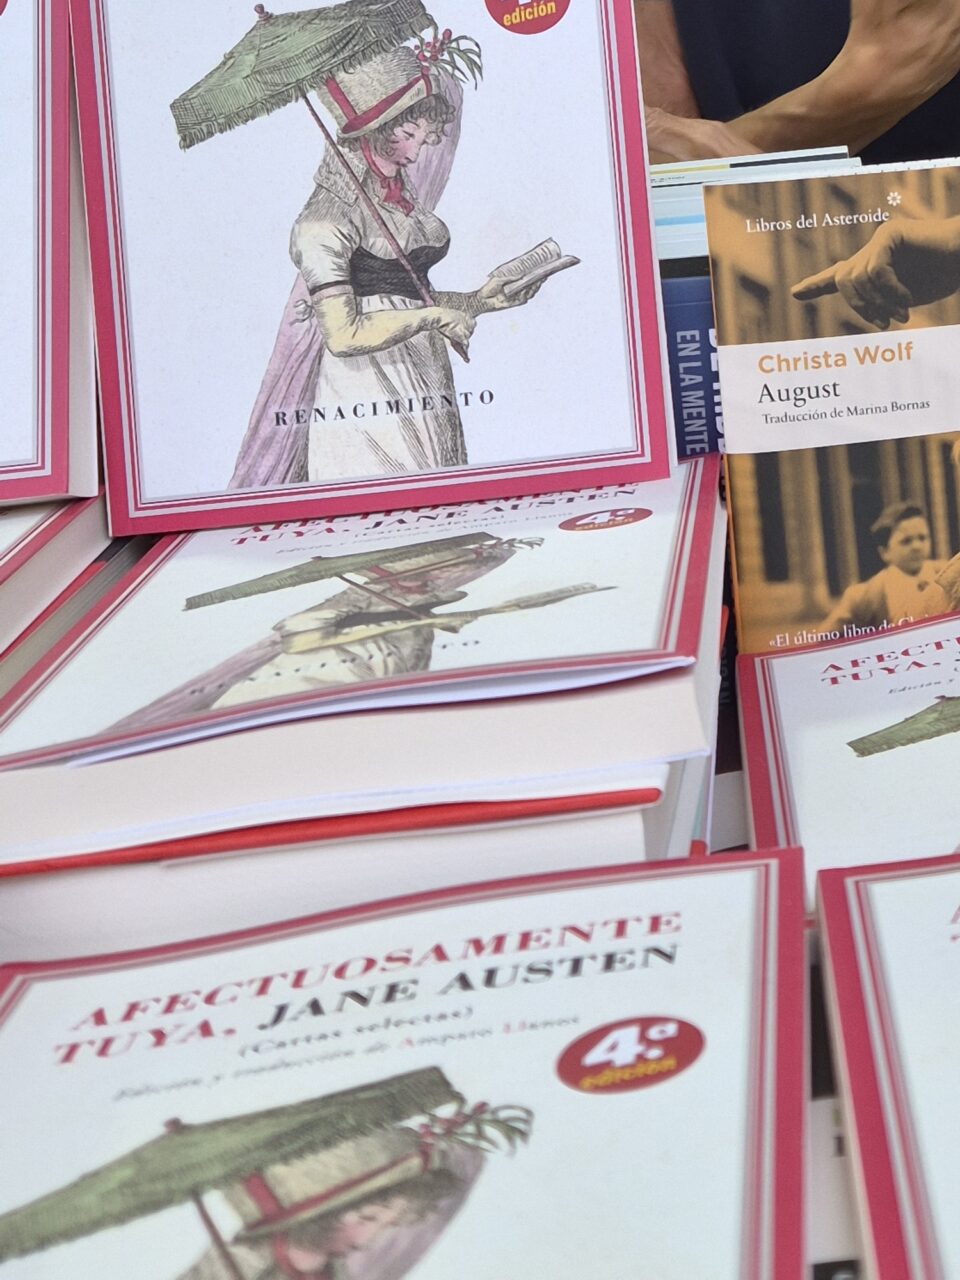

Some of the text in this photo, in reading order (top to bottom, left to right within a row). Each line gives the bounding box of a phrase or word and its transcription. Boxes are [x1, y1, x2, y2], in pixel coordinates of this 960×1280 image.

[503, 0, 556, 27] edición
[746, 207, 890, 234] Libros del Asteroide
[758, 341, 914, 375] Christa Wolf
[676, 329, 709, 456] EN LA MENTE
[758, 379, 841, 408] August
[274, 389, 495, 426] RENACIMIENTO
[762, 398, 931, 426] Traducción de Marina Bornas
[483, 489, 636, 515] AUSTEN
[365, 509, 468, 530] JANE
[794, 628, 840, 646] último
[843, 623, 876, 639] libro
[69, 911, 683, 1032] AFECTUOSAMENTE
[256, 978, 419, 1032] JANE
[436, 943, 678, 996] AUSTEN
